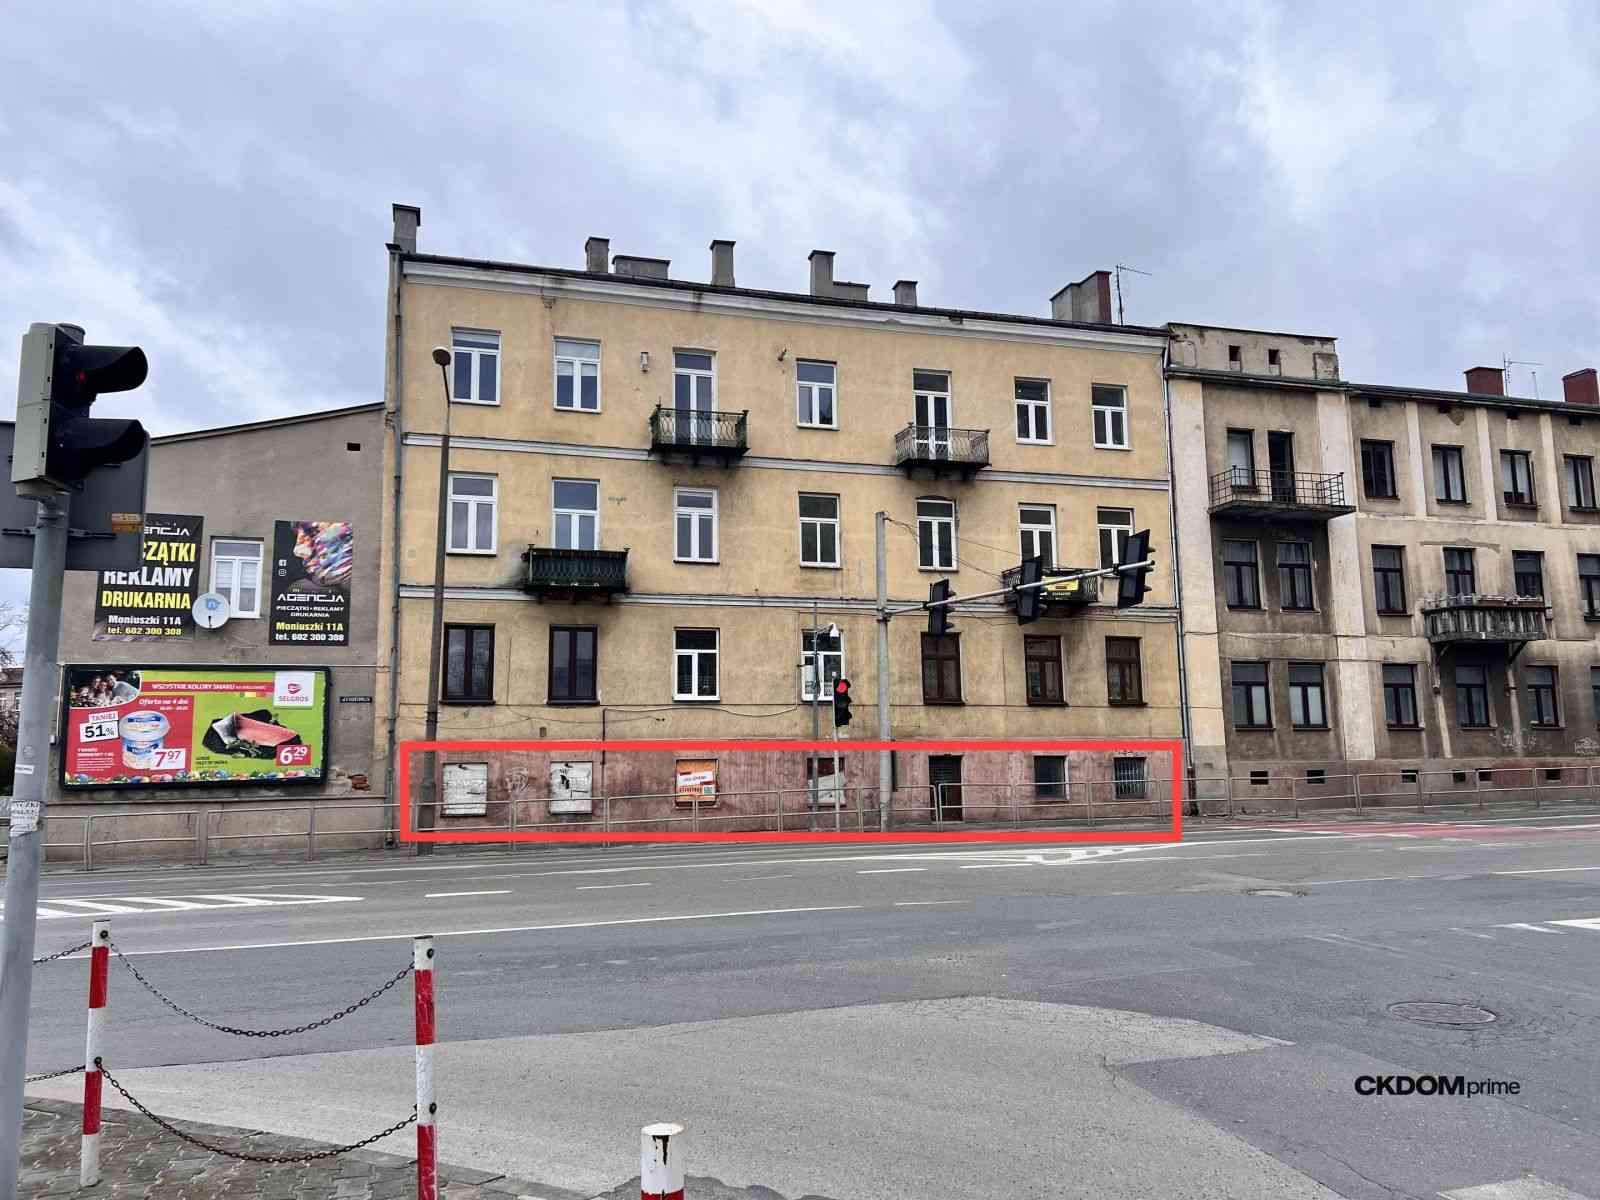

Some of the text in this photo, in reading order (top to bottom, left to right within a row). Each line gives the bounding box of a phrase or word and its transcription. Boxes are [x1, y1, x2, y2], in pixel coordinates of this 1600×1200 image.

[144, 526, 190, 536] ENCJA
[143, 541, 196, 566] ZĄTKI
[103, 566, 194, 587] REKLAMY
[101, 590, 192, 609] DRUKARNIA
[277, 593, 345, 603] AGENCJA
[108, 614, 182, 625] Moniuszki 11A
[107, 626, 122, 634] tel.
[276, 621, 344, 631] Moniuszki 11A
[275, 633, 290, 641] tel.
[278, 695, 309, 703] SELGROS
